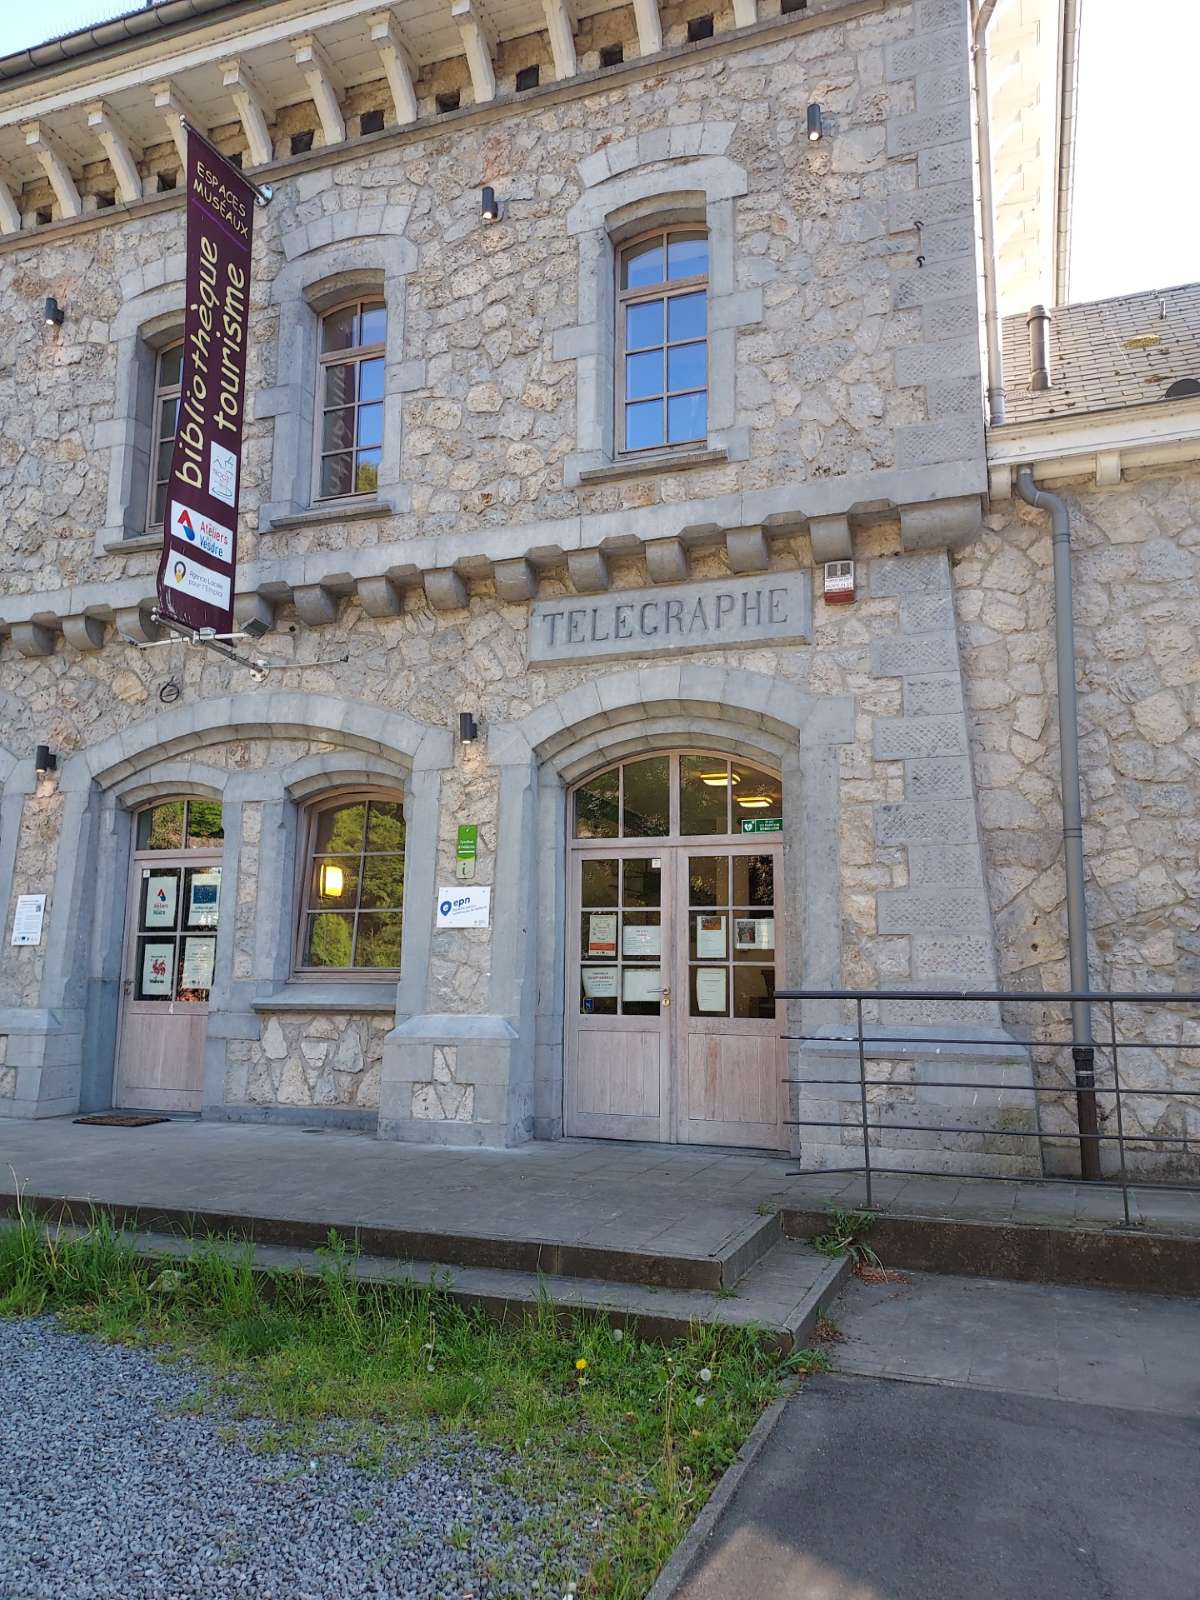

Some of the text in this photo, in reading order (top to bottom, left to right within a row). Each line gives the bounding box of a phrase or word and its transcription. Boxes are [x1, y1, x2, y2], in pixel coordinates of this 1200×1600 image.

[193, 178, 249, 240] MUSÉAUX
[197, 160, 246, 217] ESPACES
[175, 236, 220, 489] bibliothèque
[213, 262, 245, 433] tourisme
[199, 534, 224, 557] Vesdre
[200, 521, 229, 545] Ateliers
[542, 588, 789, 647] TELEGRAPHE
[453, 897, 471, 907] epn
